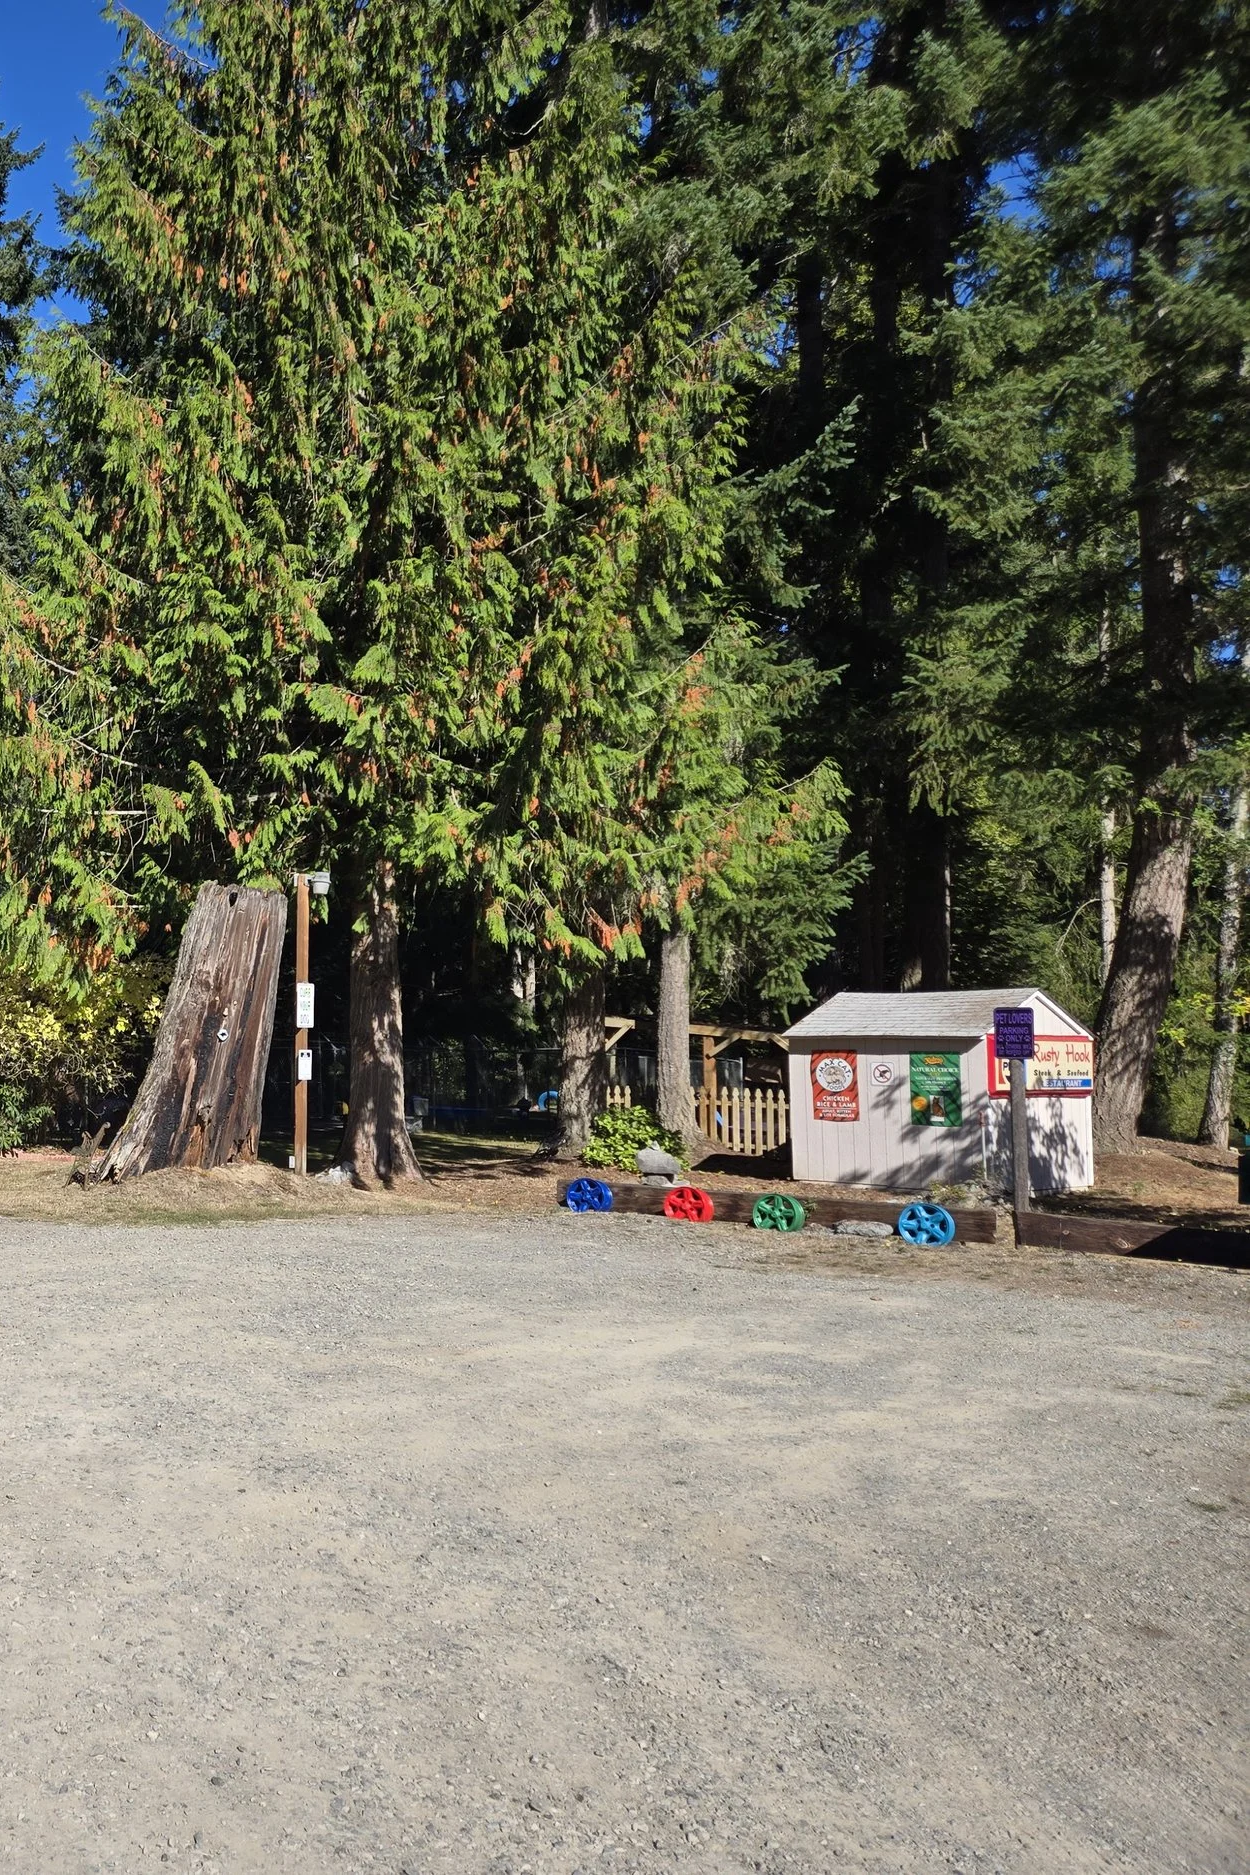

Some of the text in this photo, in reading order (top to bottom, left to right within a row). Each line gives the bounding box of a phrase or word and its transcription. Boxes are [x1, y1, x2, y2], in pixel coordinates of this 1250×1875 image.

[996, 1013, 1033, 1024] PET LOVERS
[999, 1027, 1029, 1035] PARKING
[1033, 1044, 1060, 1067] Rusty
[1066, 1044, 1090, 1063] Hook
[818, 1060, 852, 1074] MAX CAT
